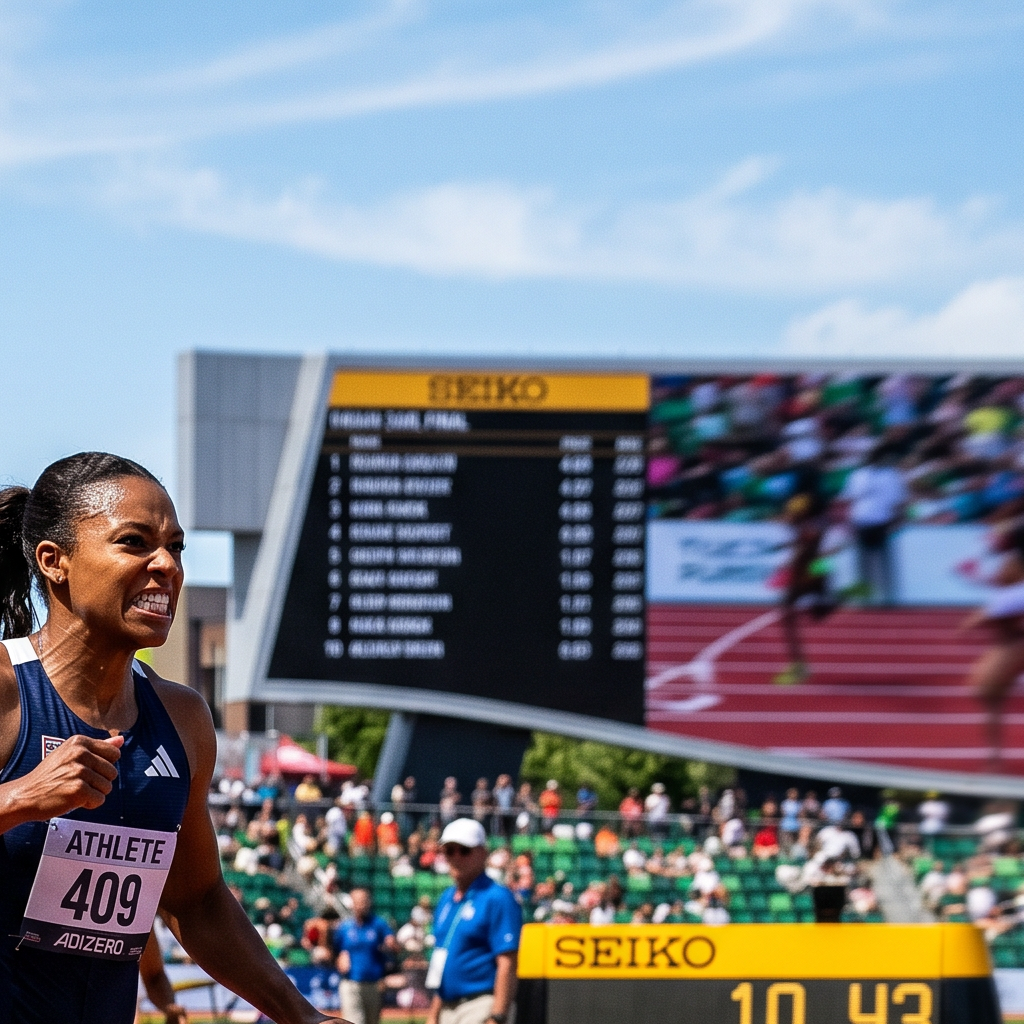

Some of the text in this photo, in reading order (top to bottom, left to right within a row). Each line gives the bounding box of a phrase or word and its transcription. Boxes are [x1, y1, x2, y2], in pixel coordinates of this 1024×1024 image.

[429, 375, 549, 402] SEIKO
[65, 829, 166, 864] ATHLETE
[60, 868, 142, 926] 409
[54, 932, 124, 955] ADIZERO
[555, 935, 716, 969] SEIKO
